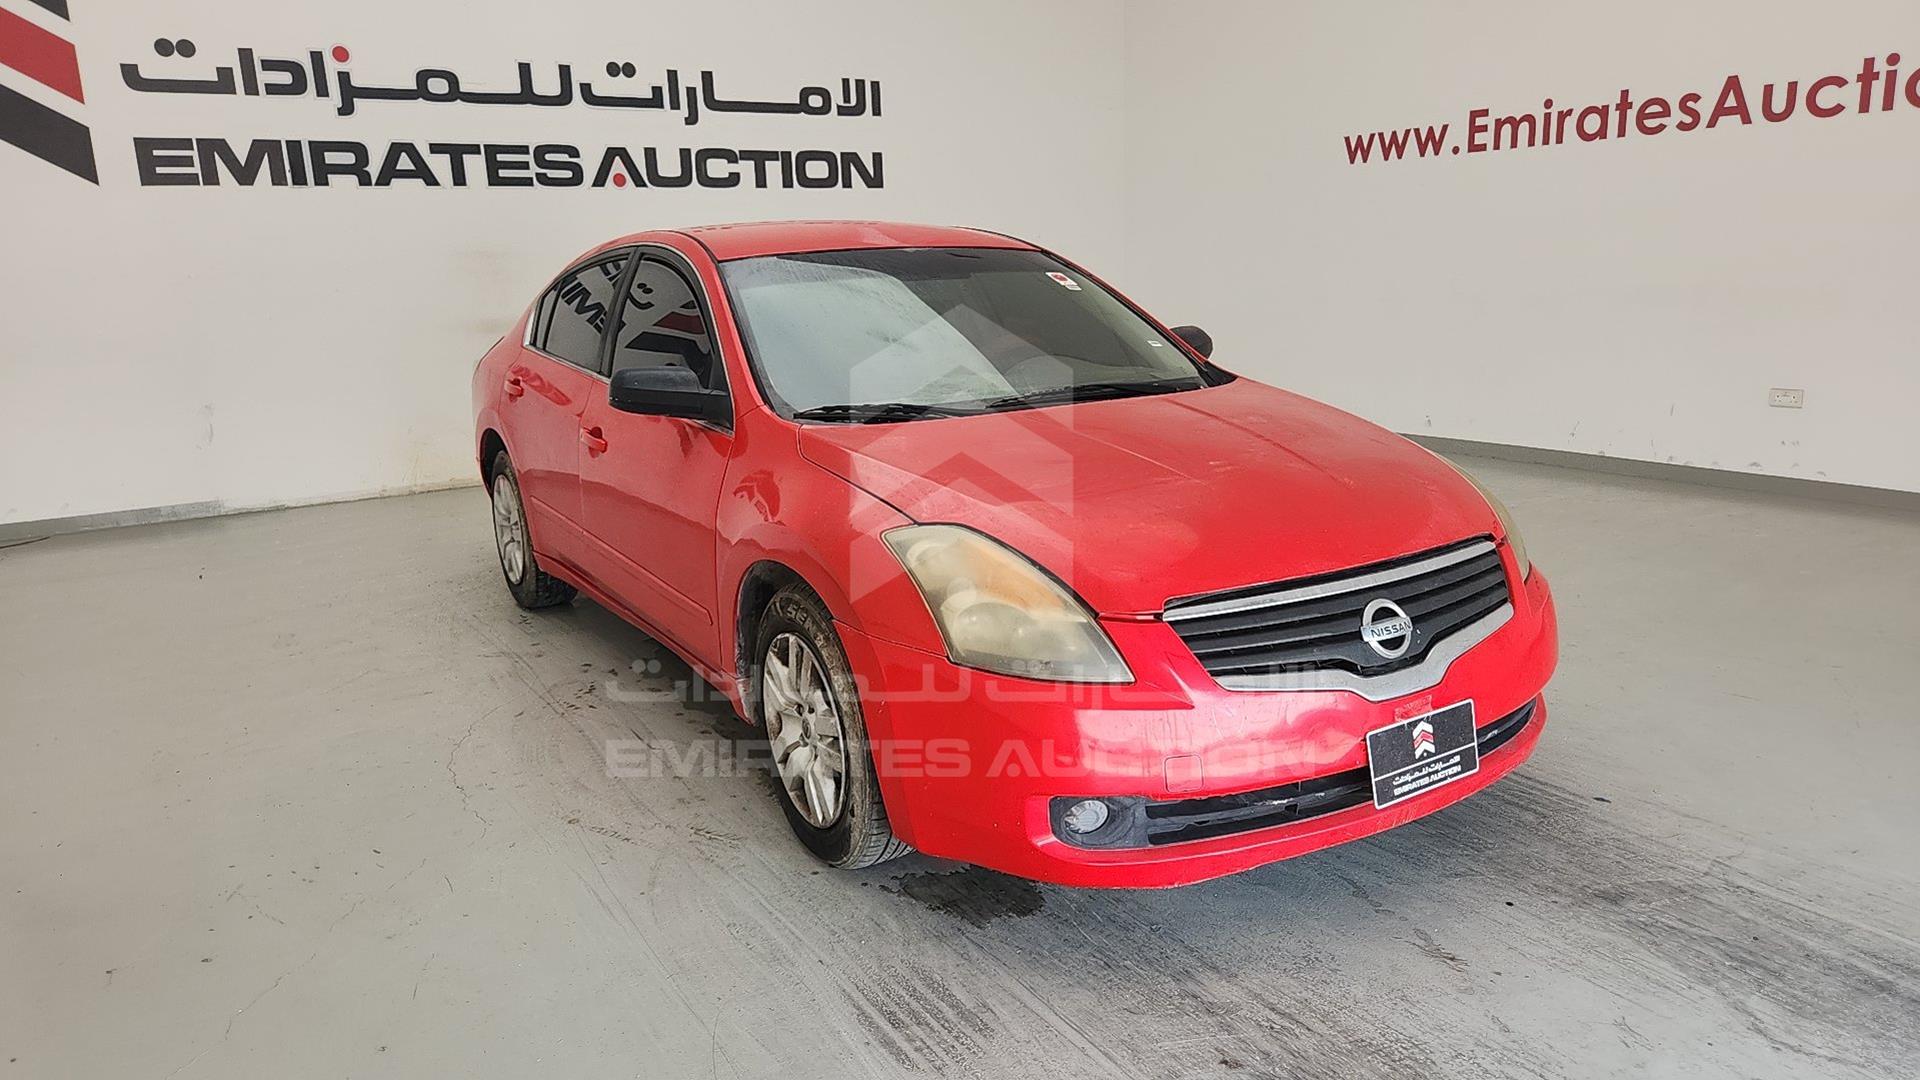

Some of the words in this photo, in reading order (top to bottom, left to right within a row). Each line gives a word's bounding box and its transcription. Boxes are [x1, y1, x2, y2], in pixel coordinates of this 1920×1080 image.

[120, 38, 573, 116] للمزادات
[579, 61, 882, 126] الامارات
[133, 137, 584, 187] EMIRATES
[591, 147, 884, 189] AUCTION
[1370, 621, 1412, 639] NISSAN
[1429, 765, 1462, 783] AUCTION
